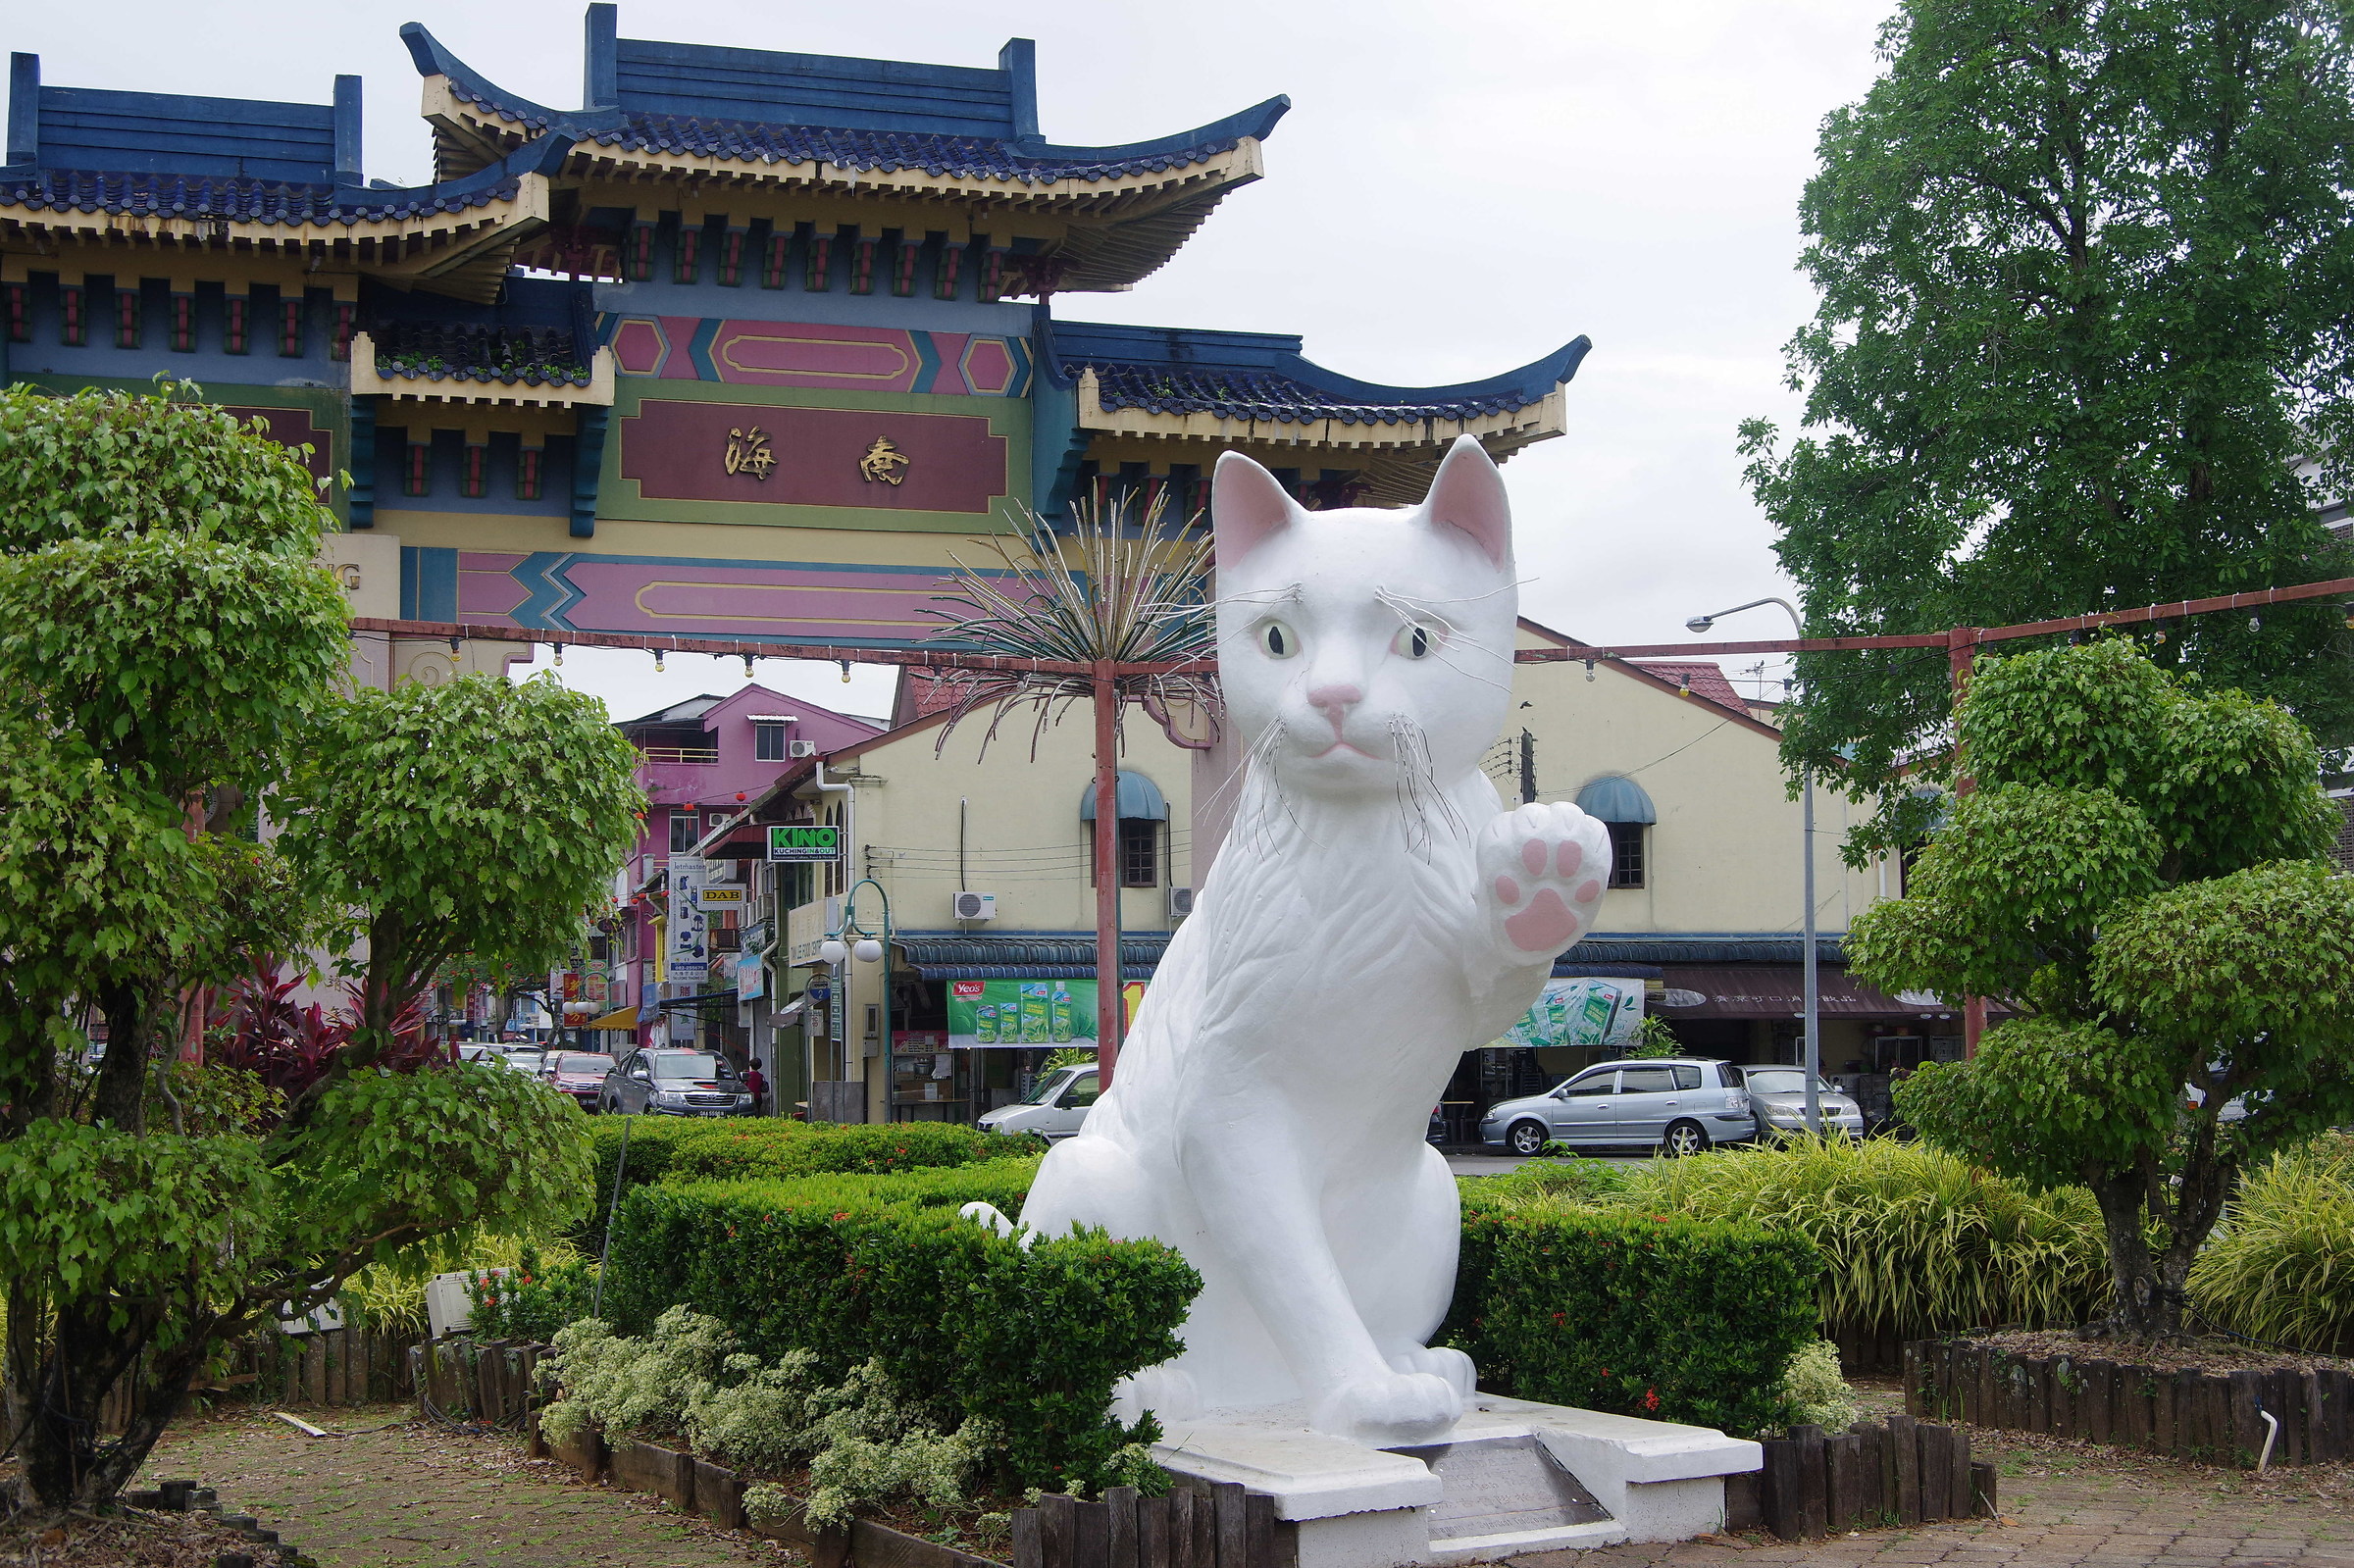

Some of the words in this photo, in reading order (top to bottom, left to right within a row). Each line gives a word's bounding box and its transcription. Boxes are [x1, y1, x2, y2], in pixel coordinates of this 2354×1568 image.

[773, 828, 837, 847] KINO
[958, 984, 980, 993] Yeo's
[818, 989, 823, 999] 2
